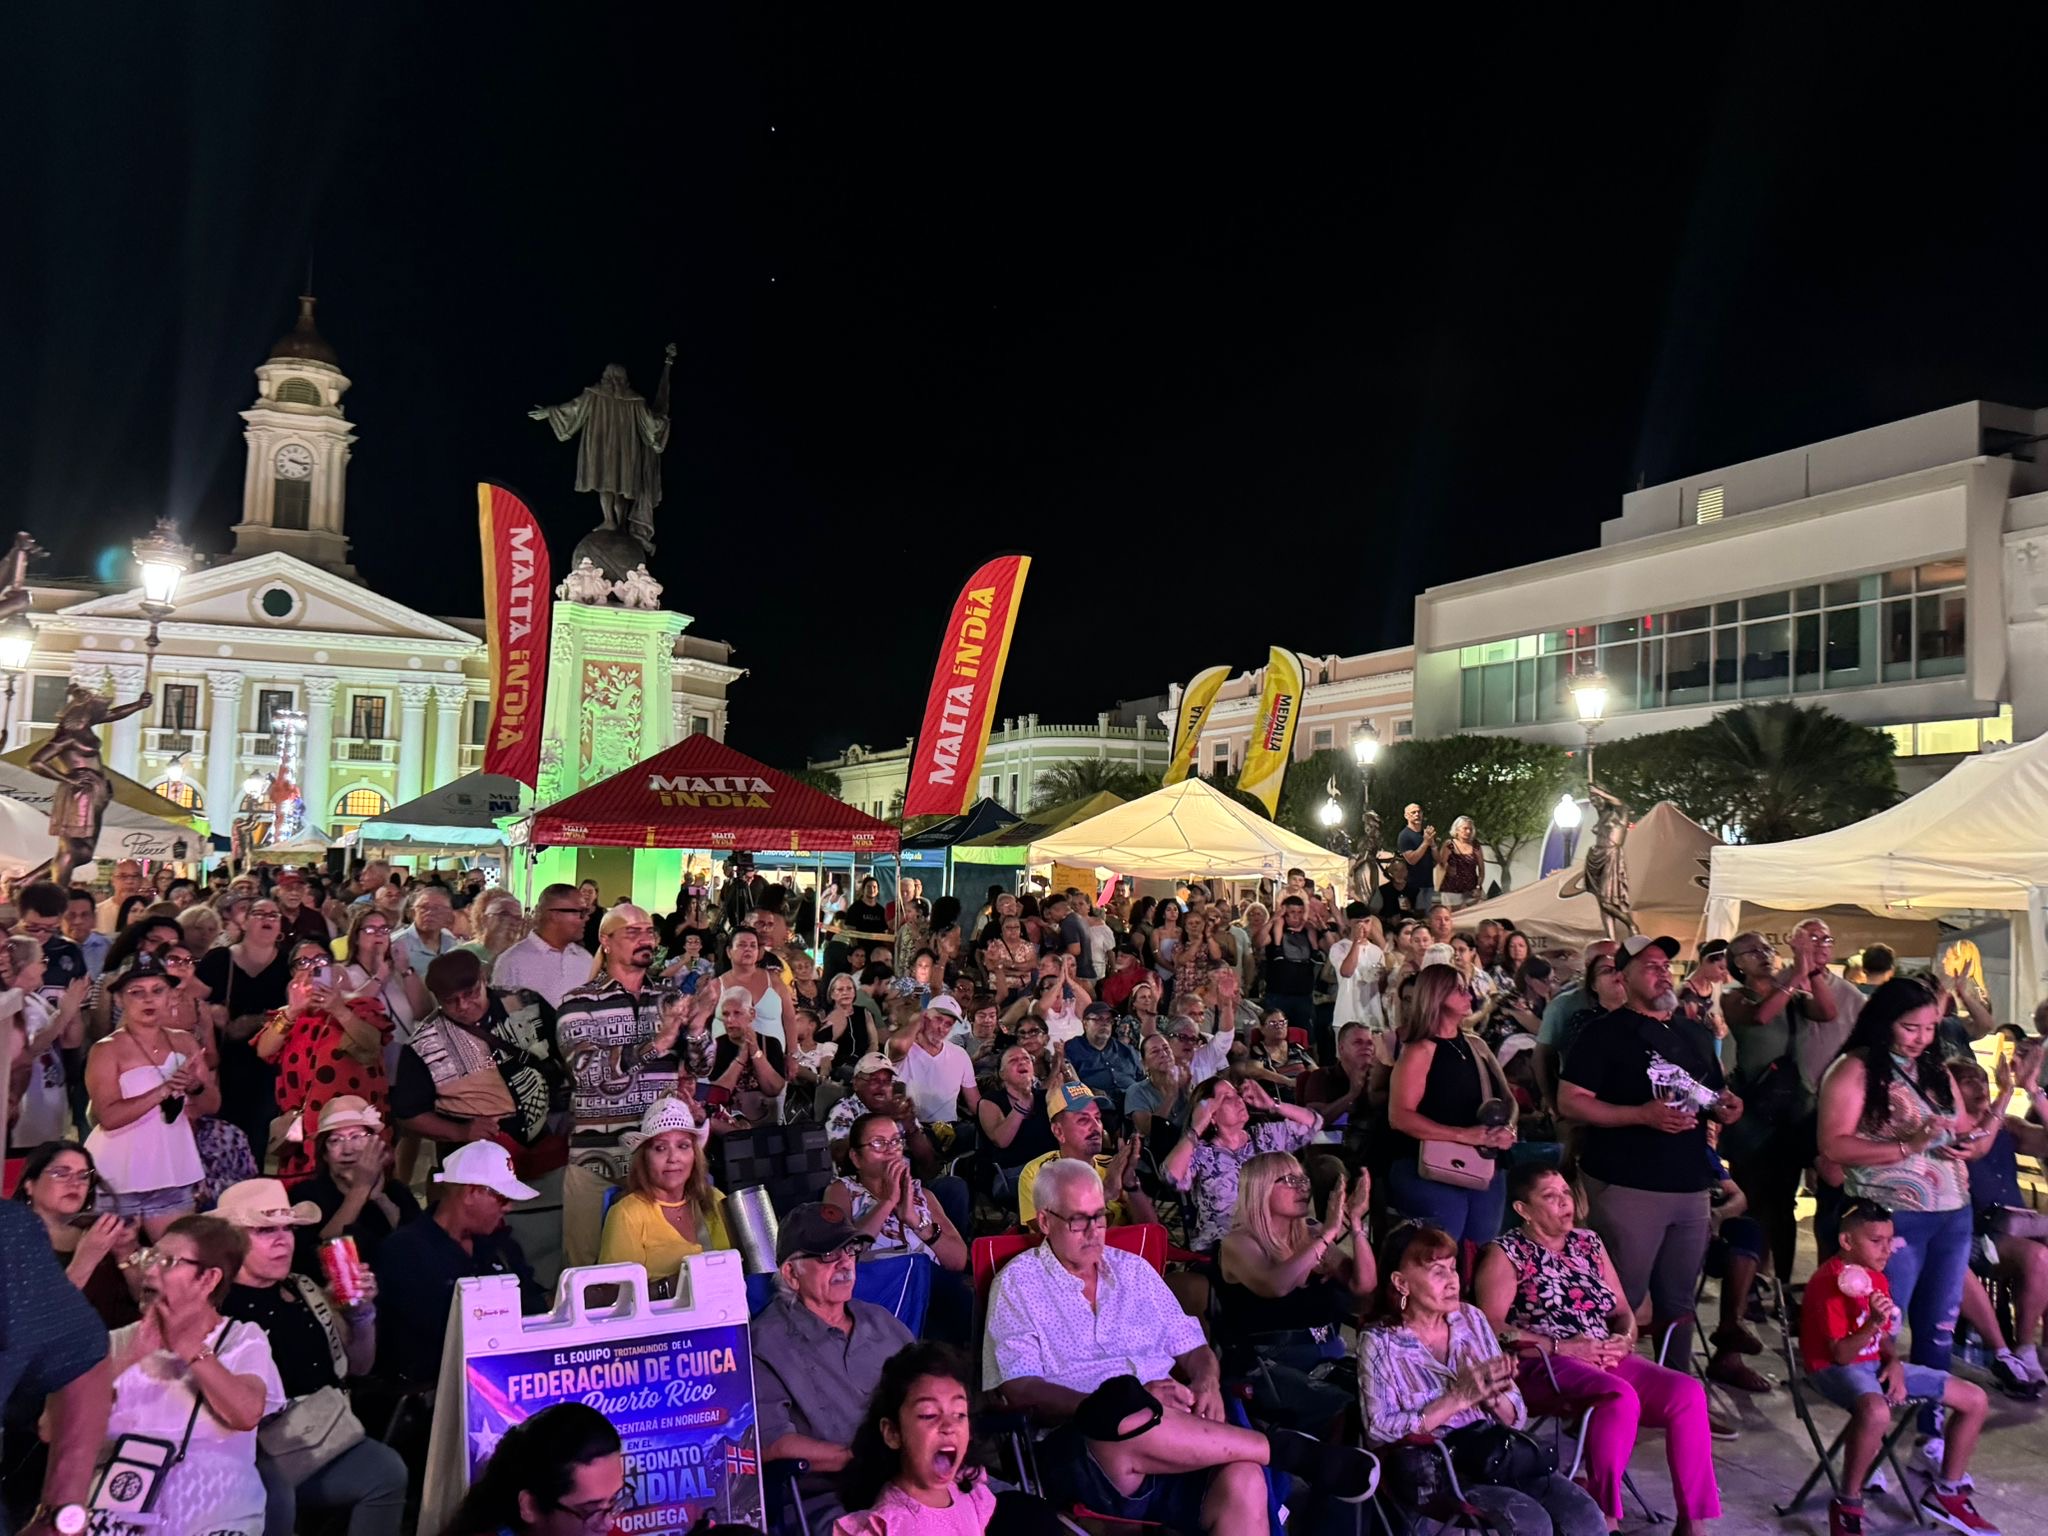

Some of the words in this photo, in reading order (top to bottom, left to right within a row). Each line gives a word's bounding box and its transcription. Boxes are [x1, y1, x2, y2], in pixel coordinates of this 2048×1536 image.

[509, 524, 535, 644] MALTA
[928, 684, 975, 785] MALTA
[1268, 694, 1293, 752] MEDALLA
[649, 774, 776, 793] MALTA
[554, 1353, 568, 1366] EL
[570, 1347, 611, 1364] EQUIPO
[614, 1342, 668, 1357] TROTAMUNDOS
[672, 1341, 682, 1350] DE
[683, 1339, 693, 1349] LA
[508, 1357, 640, 1402] FEDERACIÓN
[645, 1356, 672, 1383] DE
[676, 1347, 737, 1378] CUICA
[665, 1379, 717, 1408] Rico
[614, 1417, 659, 1435] SENTARÁ
[661, 1416, 673, 1429] EN
[675, 1409, 720, 1427] NORUEGA!
[627, 1440, 642, 1450] EN
[643, 1439, 653, 1449] EL
[620, 1445, 701, 1475] PEONATO
[624, 1466, 717, 1508] NDIAL
